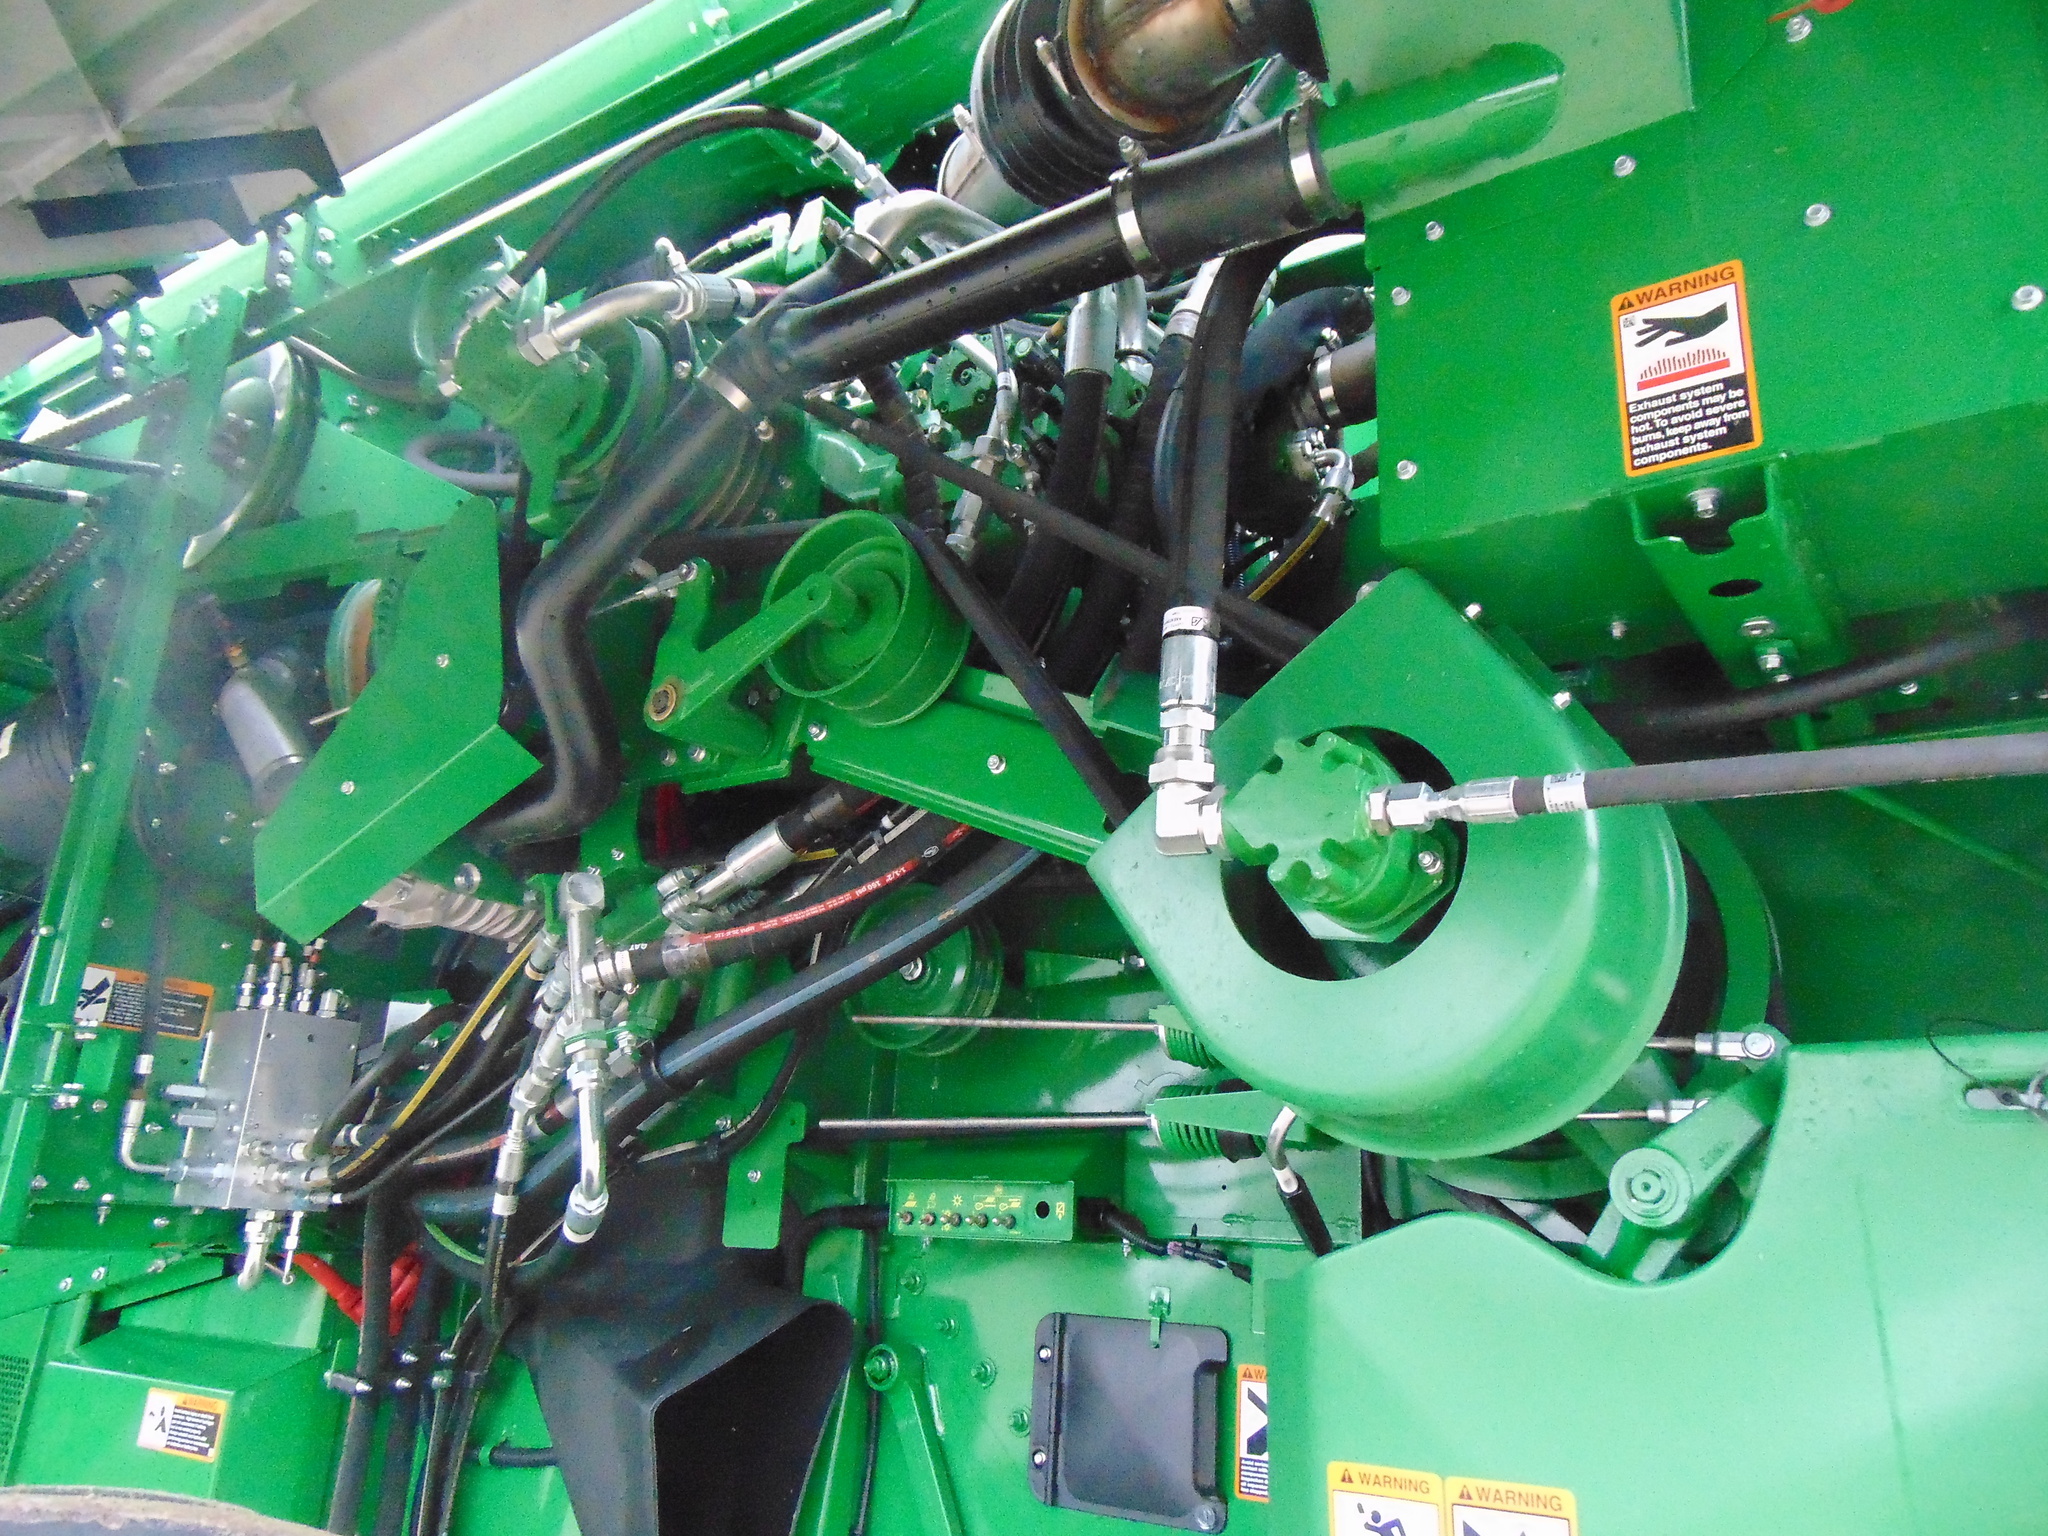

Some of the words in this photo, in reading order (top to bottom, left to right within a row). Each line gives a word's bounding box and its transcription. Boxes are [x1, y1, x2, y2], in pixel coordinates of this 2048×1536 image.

[1636, 266, 1735, 305] WARNING
[1629, 393, 1677, 413] Exhaust
[1680, 382, 1724, 401] system
[1629, 399, 1700, 424] components
[1702, 393, 1726, 407] may
[1728, 388, 1744, 400] be
[1630, 422, 1653, 435] hot.
[1655, 419, 1668, 429] To
[1671, 408, 1703, 425] avoid
[1706, 399, 1746, 415] severe
[1666, 424, 1692, 438] keep
[1694, 417, 1722, 432] away
[1723, 409, 1749, 422] from
[1632, 436, 1680, 456] exhaust
[1682, 425, 1727, 445] system
[1633, 441, 1712, 467] components.
[1358, 1471, 1430, 1495] WARNING
[1475, 1486, 1563, 1513] WARNING
